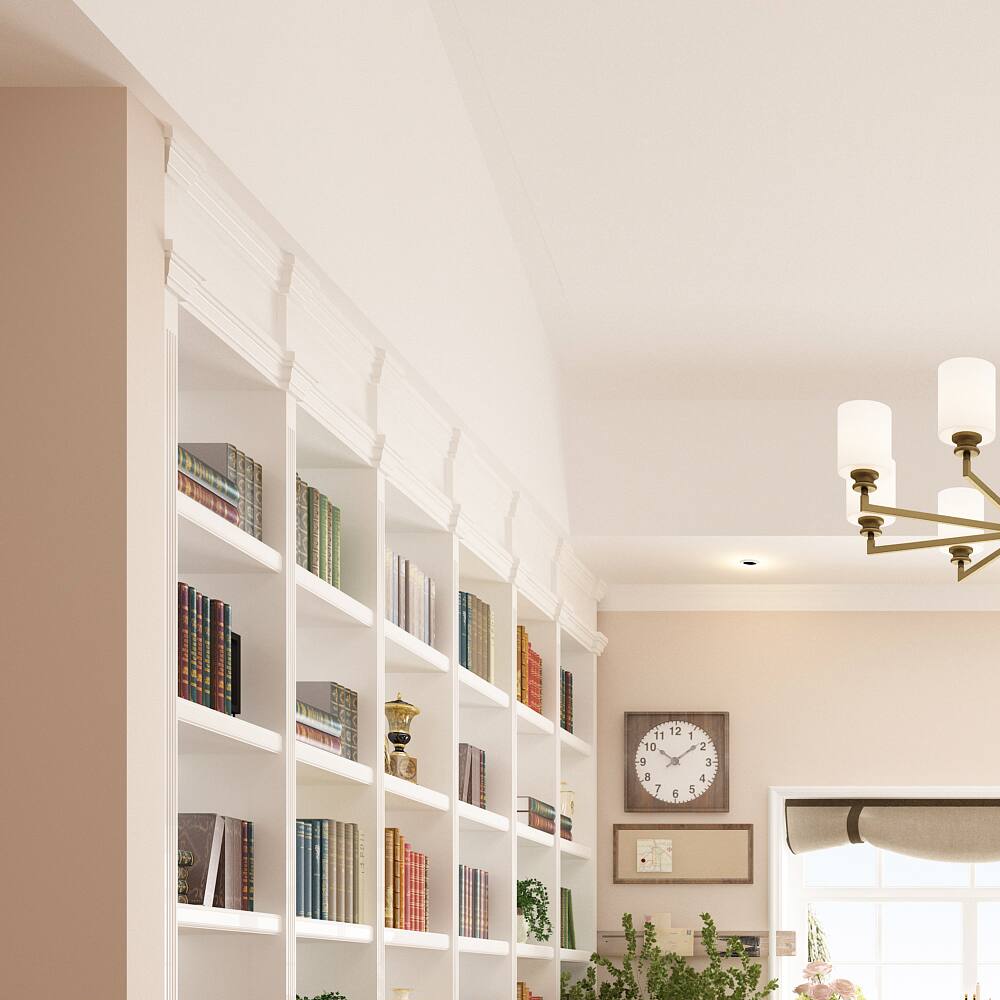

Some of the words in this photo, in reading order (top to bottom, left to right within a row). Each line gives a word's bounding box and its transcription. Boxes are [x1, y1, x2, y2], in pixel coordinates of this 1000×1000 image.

[670, 726, 681, 736] 12
[654, 731, 664, 740] 11
[645, 742, 656, 751] 10
[700, 742, 706, 751] 2
[640, 758, 646, 766] 9
[706, 758, 711, 766] 3
[645, 773, 650, 781] 8
[700, 774, 705, 782] 4
[655, 784, 661, 793] 7
[689, 785, 695, 793] 5
[673, 790, 678, 798] 6
